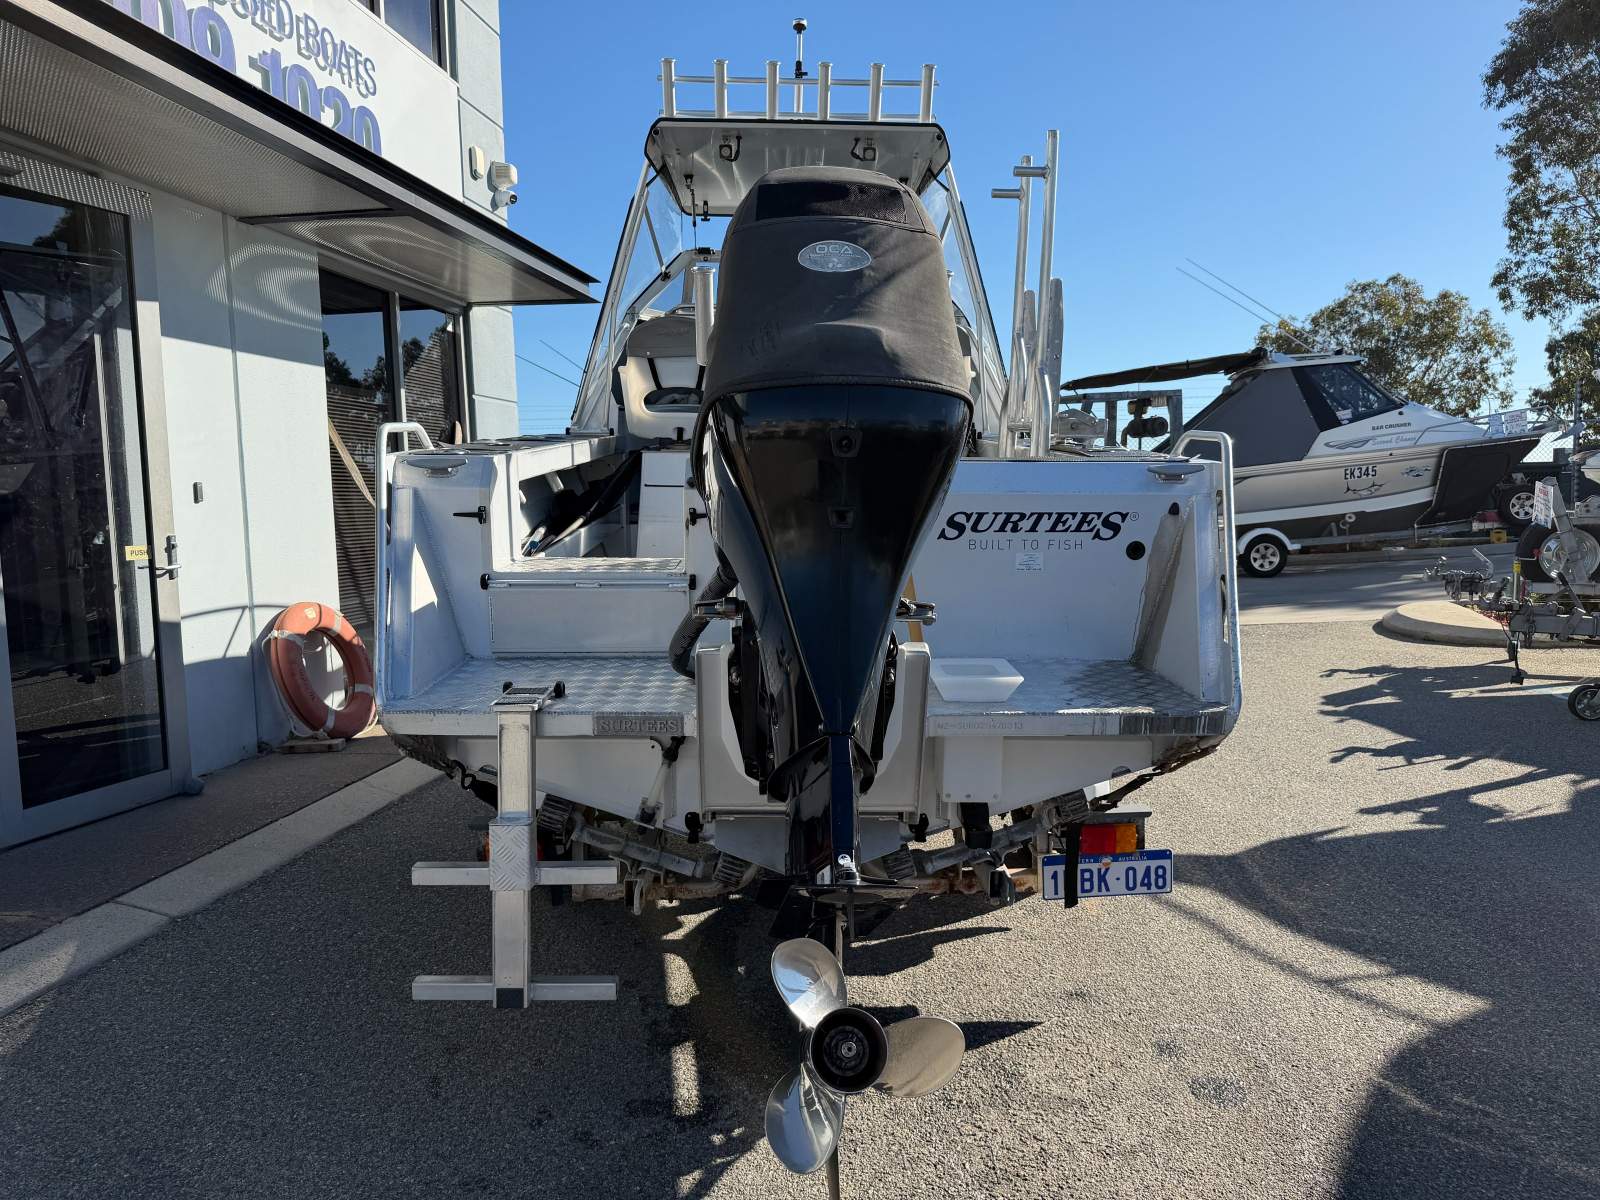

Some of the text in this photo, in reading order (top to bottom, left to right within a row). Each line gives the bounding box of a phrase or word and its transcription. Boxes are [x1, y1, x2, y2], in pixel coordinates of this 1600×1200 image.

[295, 12, 377, 98] BOATS
[815, 244, 853, 254] OCA
[1343, 465, 1377, 480] EK345
[968, 539, 1084, 550] BUILT TO FISH
[130, 549, 149, 557] PUSH
